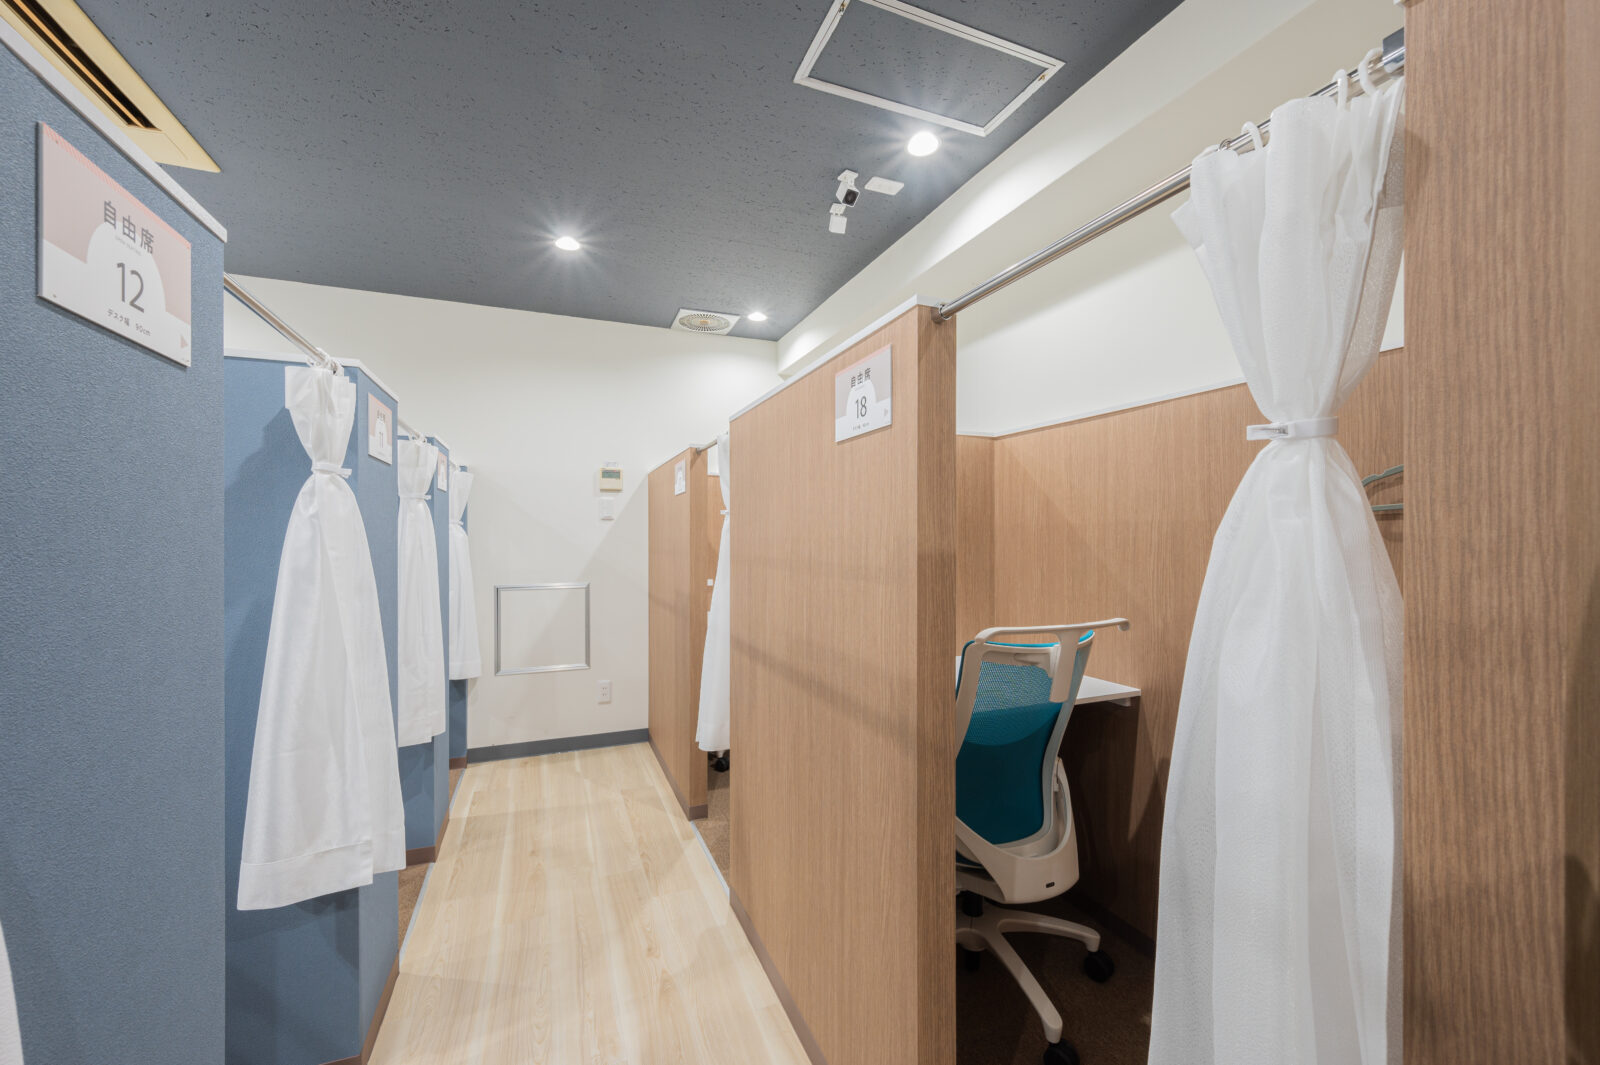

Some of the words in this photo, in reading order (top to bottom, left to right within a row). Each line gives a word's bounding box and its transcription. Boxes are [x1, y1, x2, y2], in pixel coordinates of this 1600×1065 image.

[104, 200, 154, 254] 自由席
[117, 262, 144, 313] 12
[855, 395, 868, 419] 18
